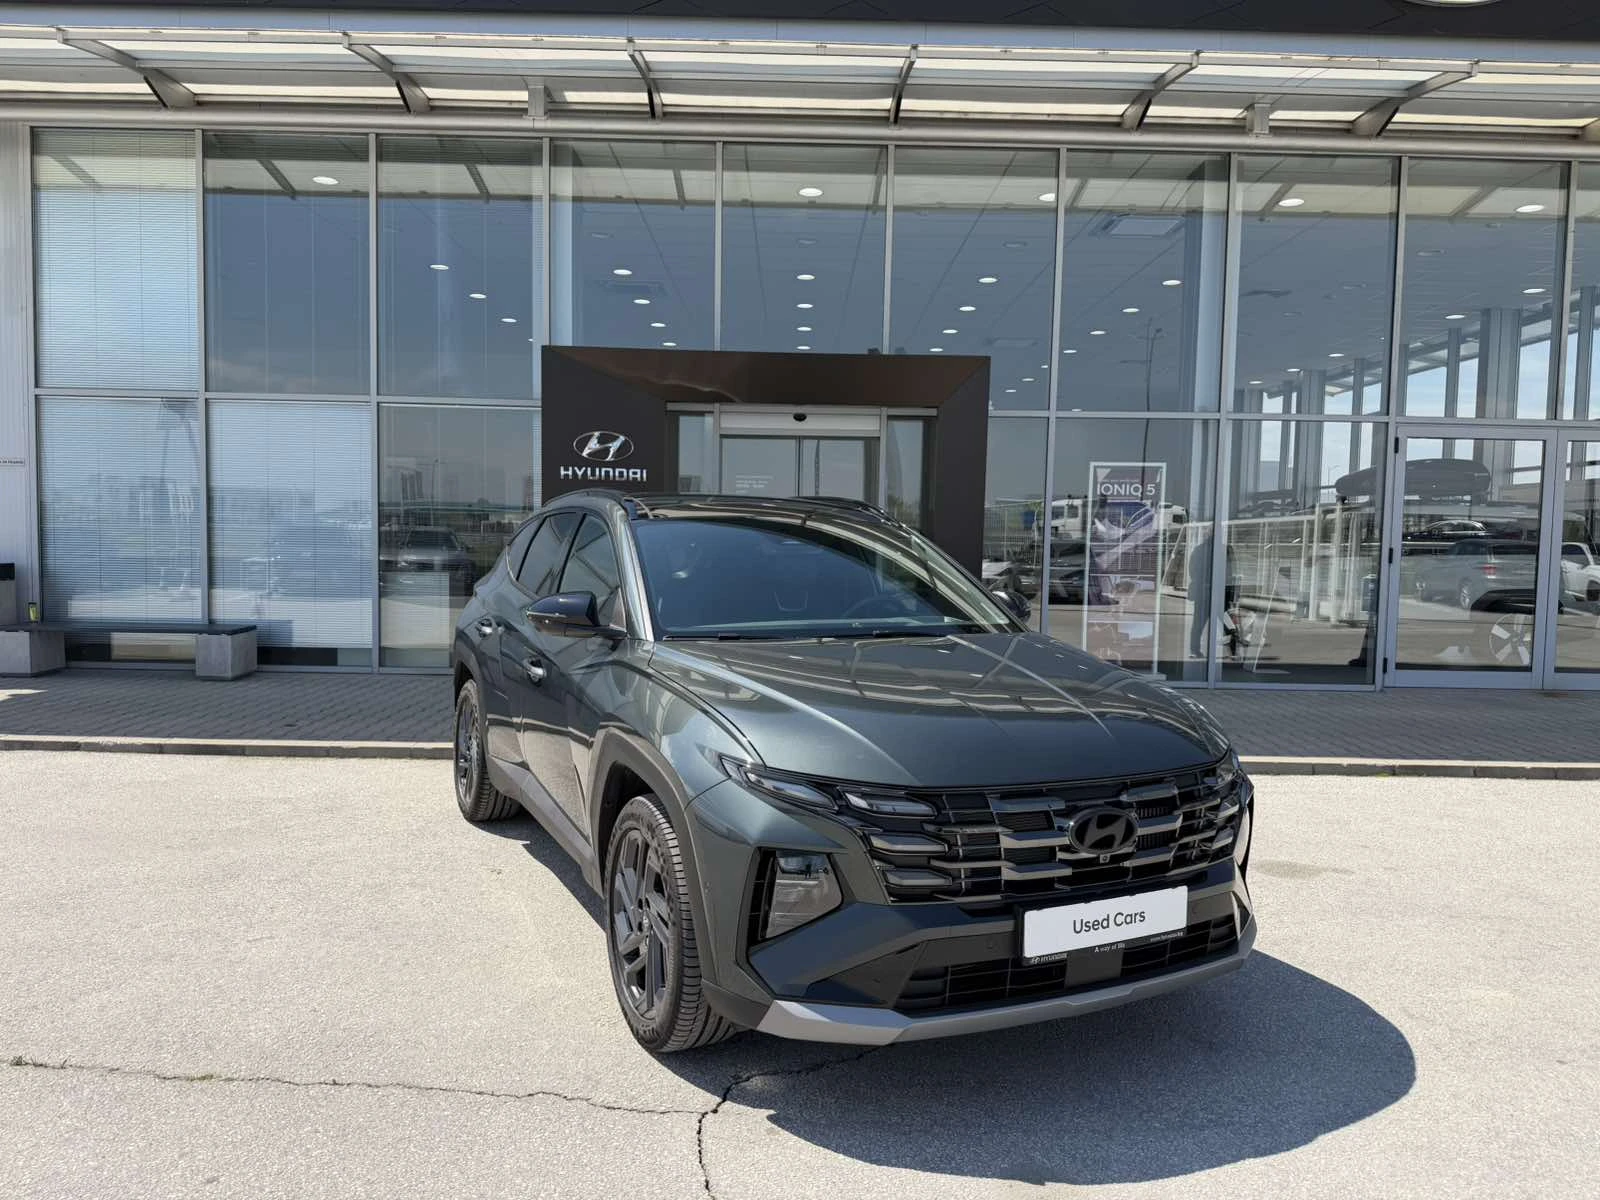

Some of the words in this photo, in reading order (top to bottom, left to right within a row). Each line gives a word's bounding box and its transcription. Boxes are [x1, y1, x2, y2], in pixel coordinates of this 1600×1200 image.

[560, 466, 647, 482] HYUNDAI
[1096, 483, 1143, 497] IONIQ
[1146, 483, 1156, 496] 5
[1073, 914, 1110, 934] Used
[1113, 911, 1146, 927] Cars
